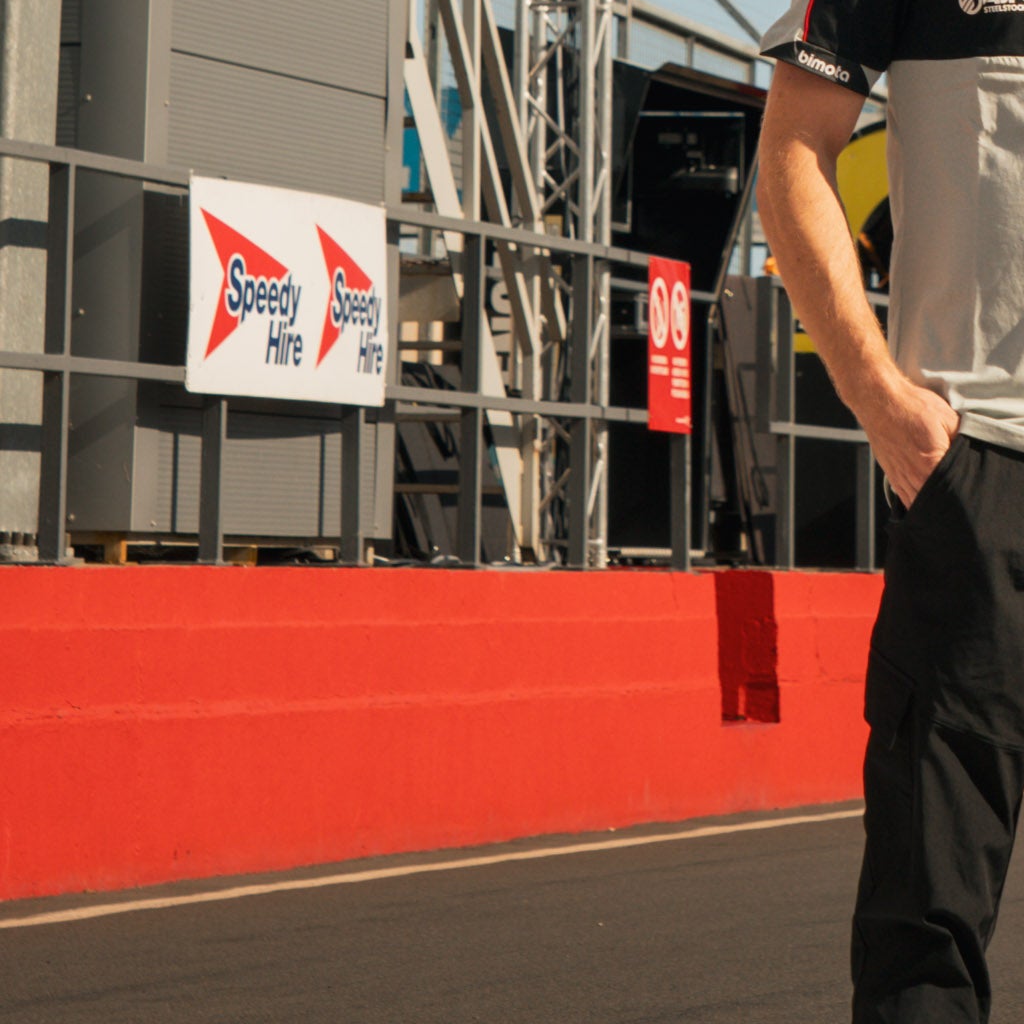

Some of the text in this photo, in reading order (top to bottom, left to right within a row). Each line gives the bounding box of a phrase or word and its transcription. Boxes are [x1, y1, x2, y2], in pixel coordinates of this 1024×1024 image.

[797, 49, 851, 83] bimota
[227, 258, 302, 326] Speedy
[332, 270, 382, 336] Speedy
[265, 320, 303, 367] Hire
[356, 331, 384, 376] Hire
